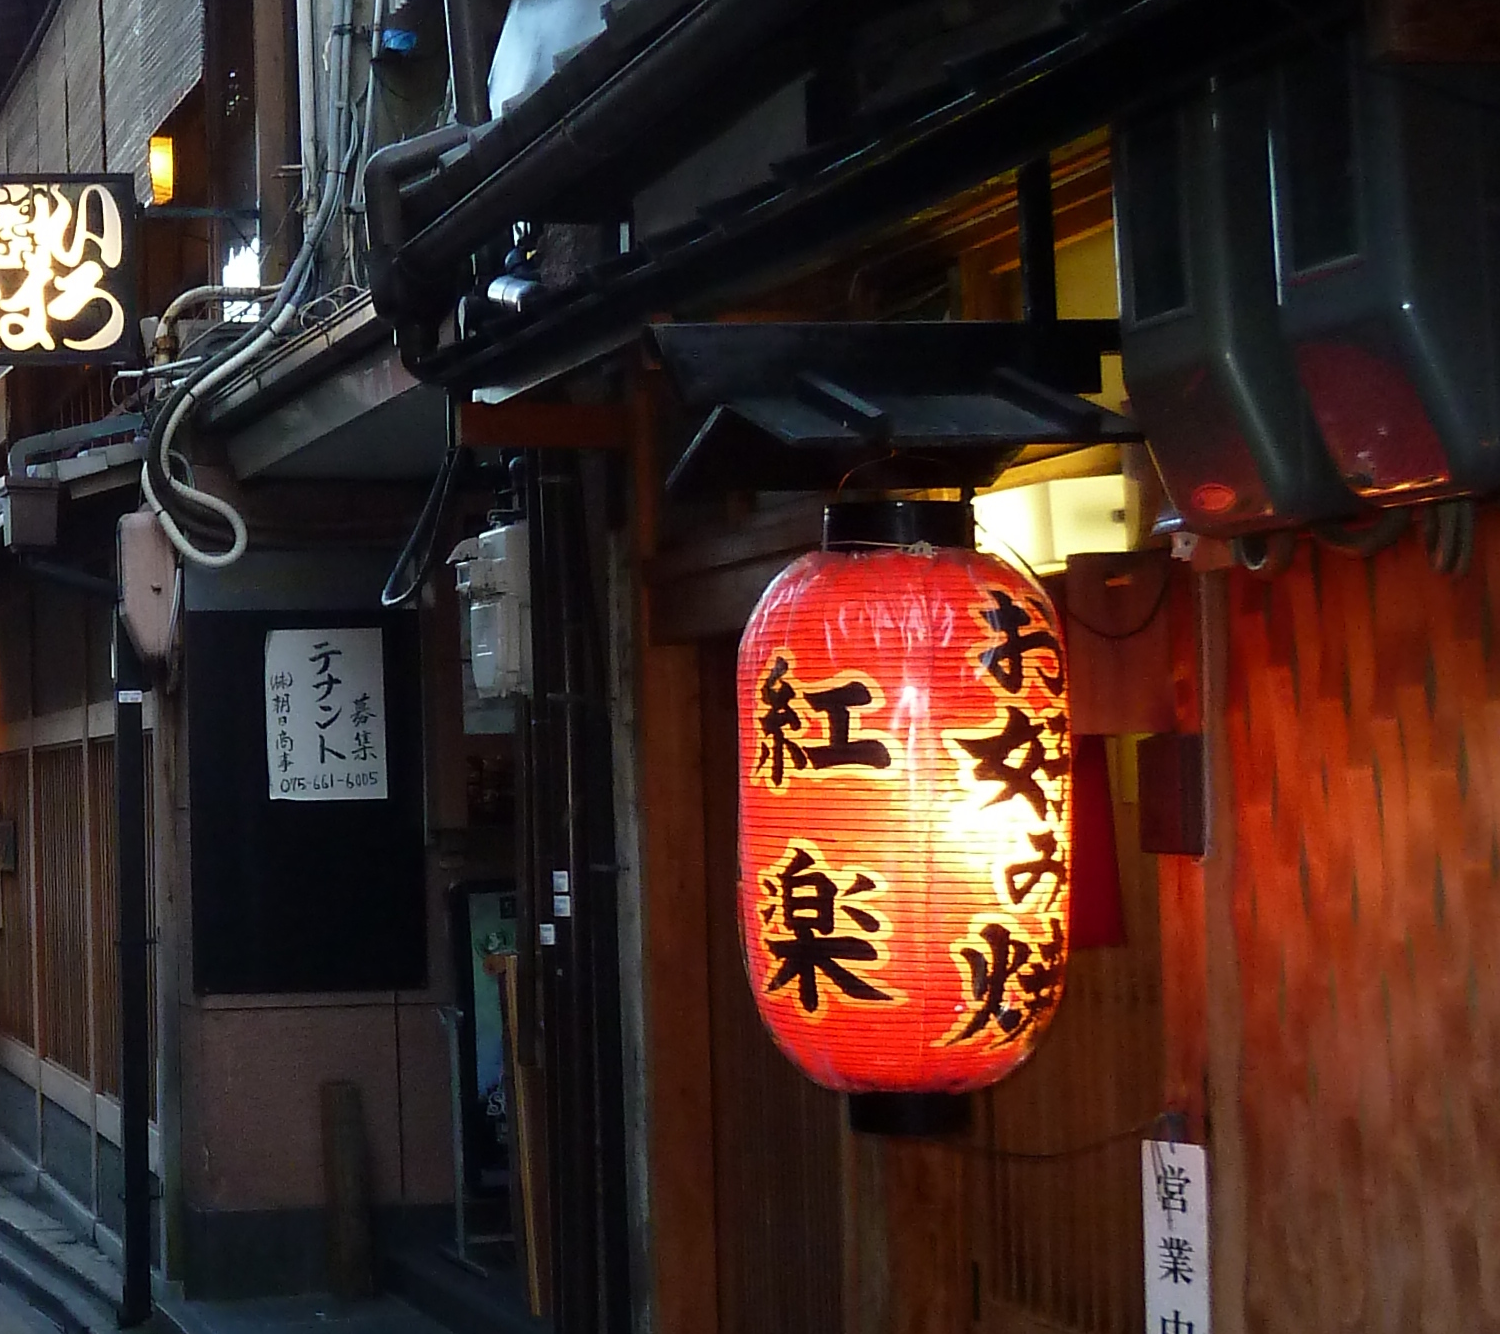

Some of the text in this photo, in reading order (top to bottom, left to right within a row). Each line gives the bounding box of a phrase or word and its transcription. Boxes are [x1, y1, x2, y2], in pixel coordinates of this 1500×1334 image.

[308, 640, 346, 764] テナント
[350, 692, 378, 762] 募集
[280, 771, 379, 793] 075-661-6005
[756, 655, 894, 1014] 紅楽
